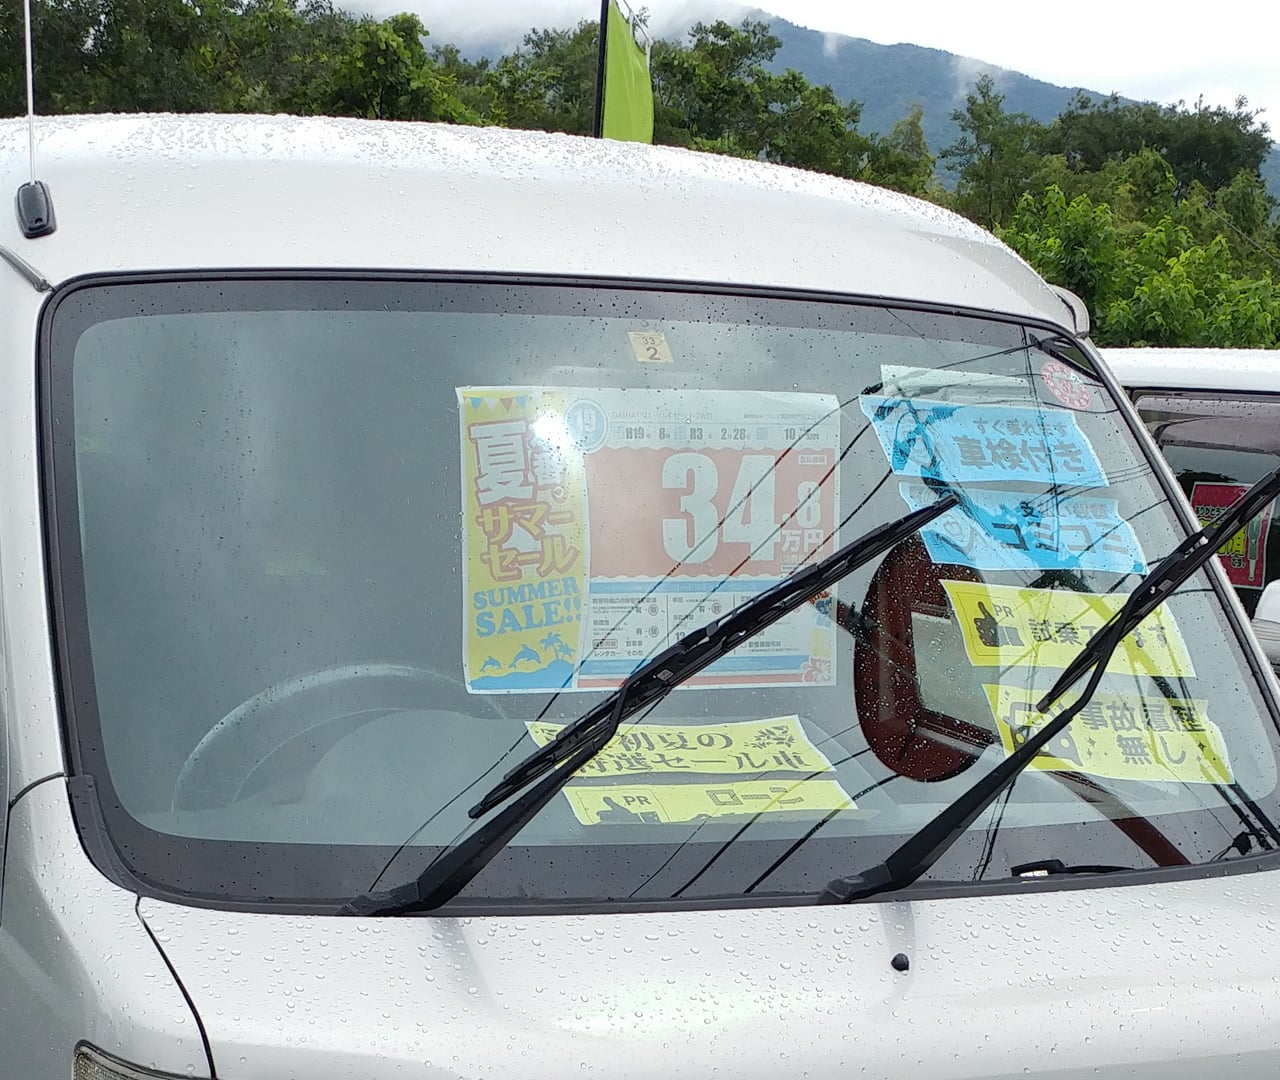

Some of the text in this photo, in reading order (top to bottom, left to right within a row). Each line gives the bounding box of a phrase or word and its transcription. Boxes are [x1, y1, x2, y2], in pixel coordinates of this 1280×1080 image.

[646, 346, 661, 361] 2
[470, 420, 535, 504] 夏
[954, 435, 1086, 473] 車検付き
[476, 501, 576, 543] サマー
[991, 520, 1130, 556] コミコミ
[481, 534, 581, 580] セール
[473, 576, 579, 610] SUMMER
[992, 604, 1014, 618] PR
[475, 596, 582, 638] SALE!!
[617, 731, 733, 752] 初夏の
[623, 795, 650, 806] PR
